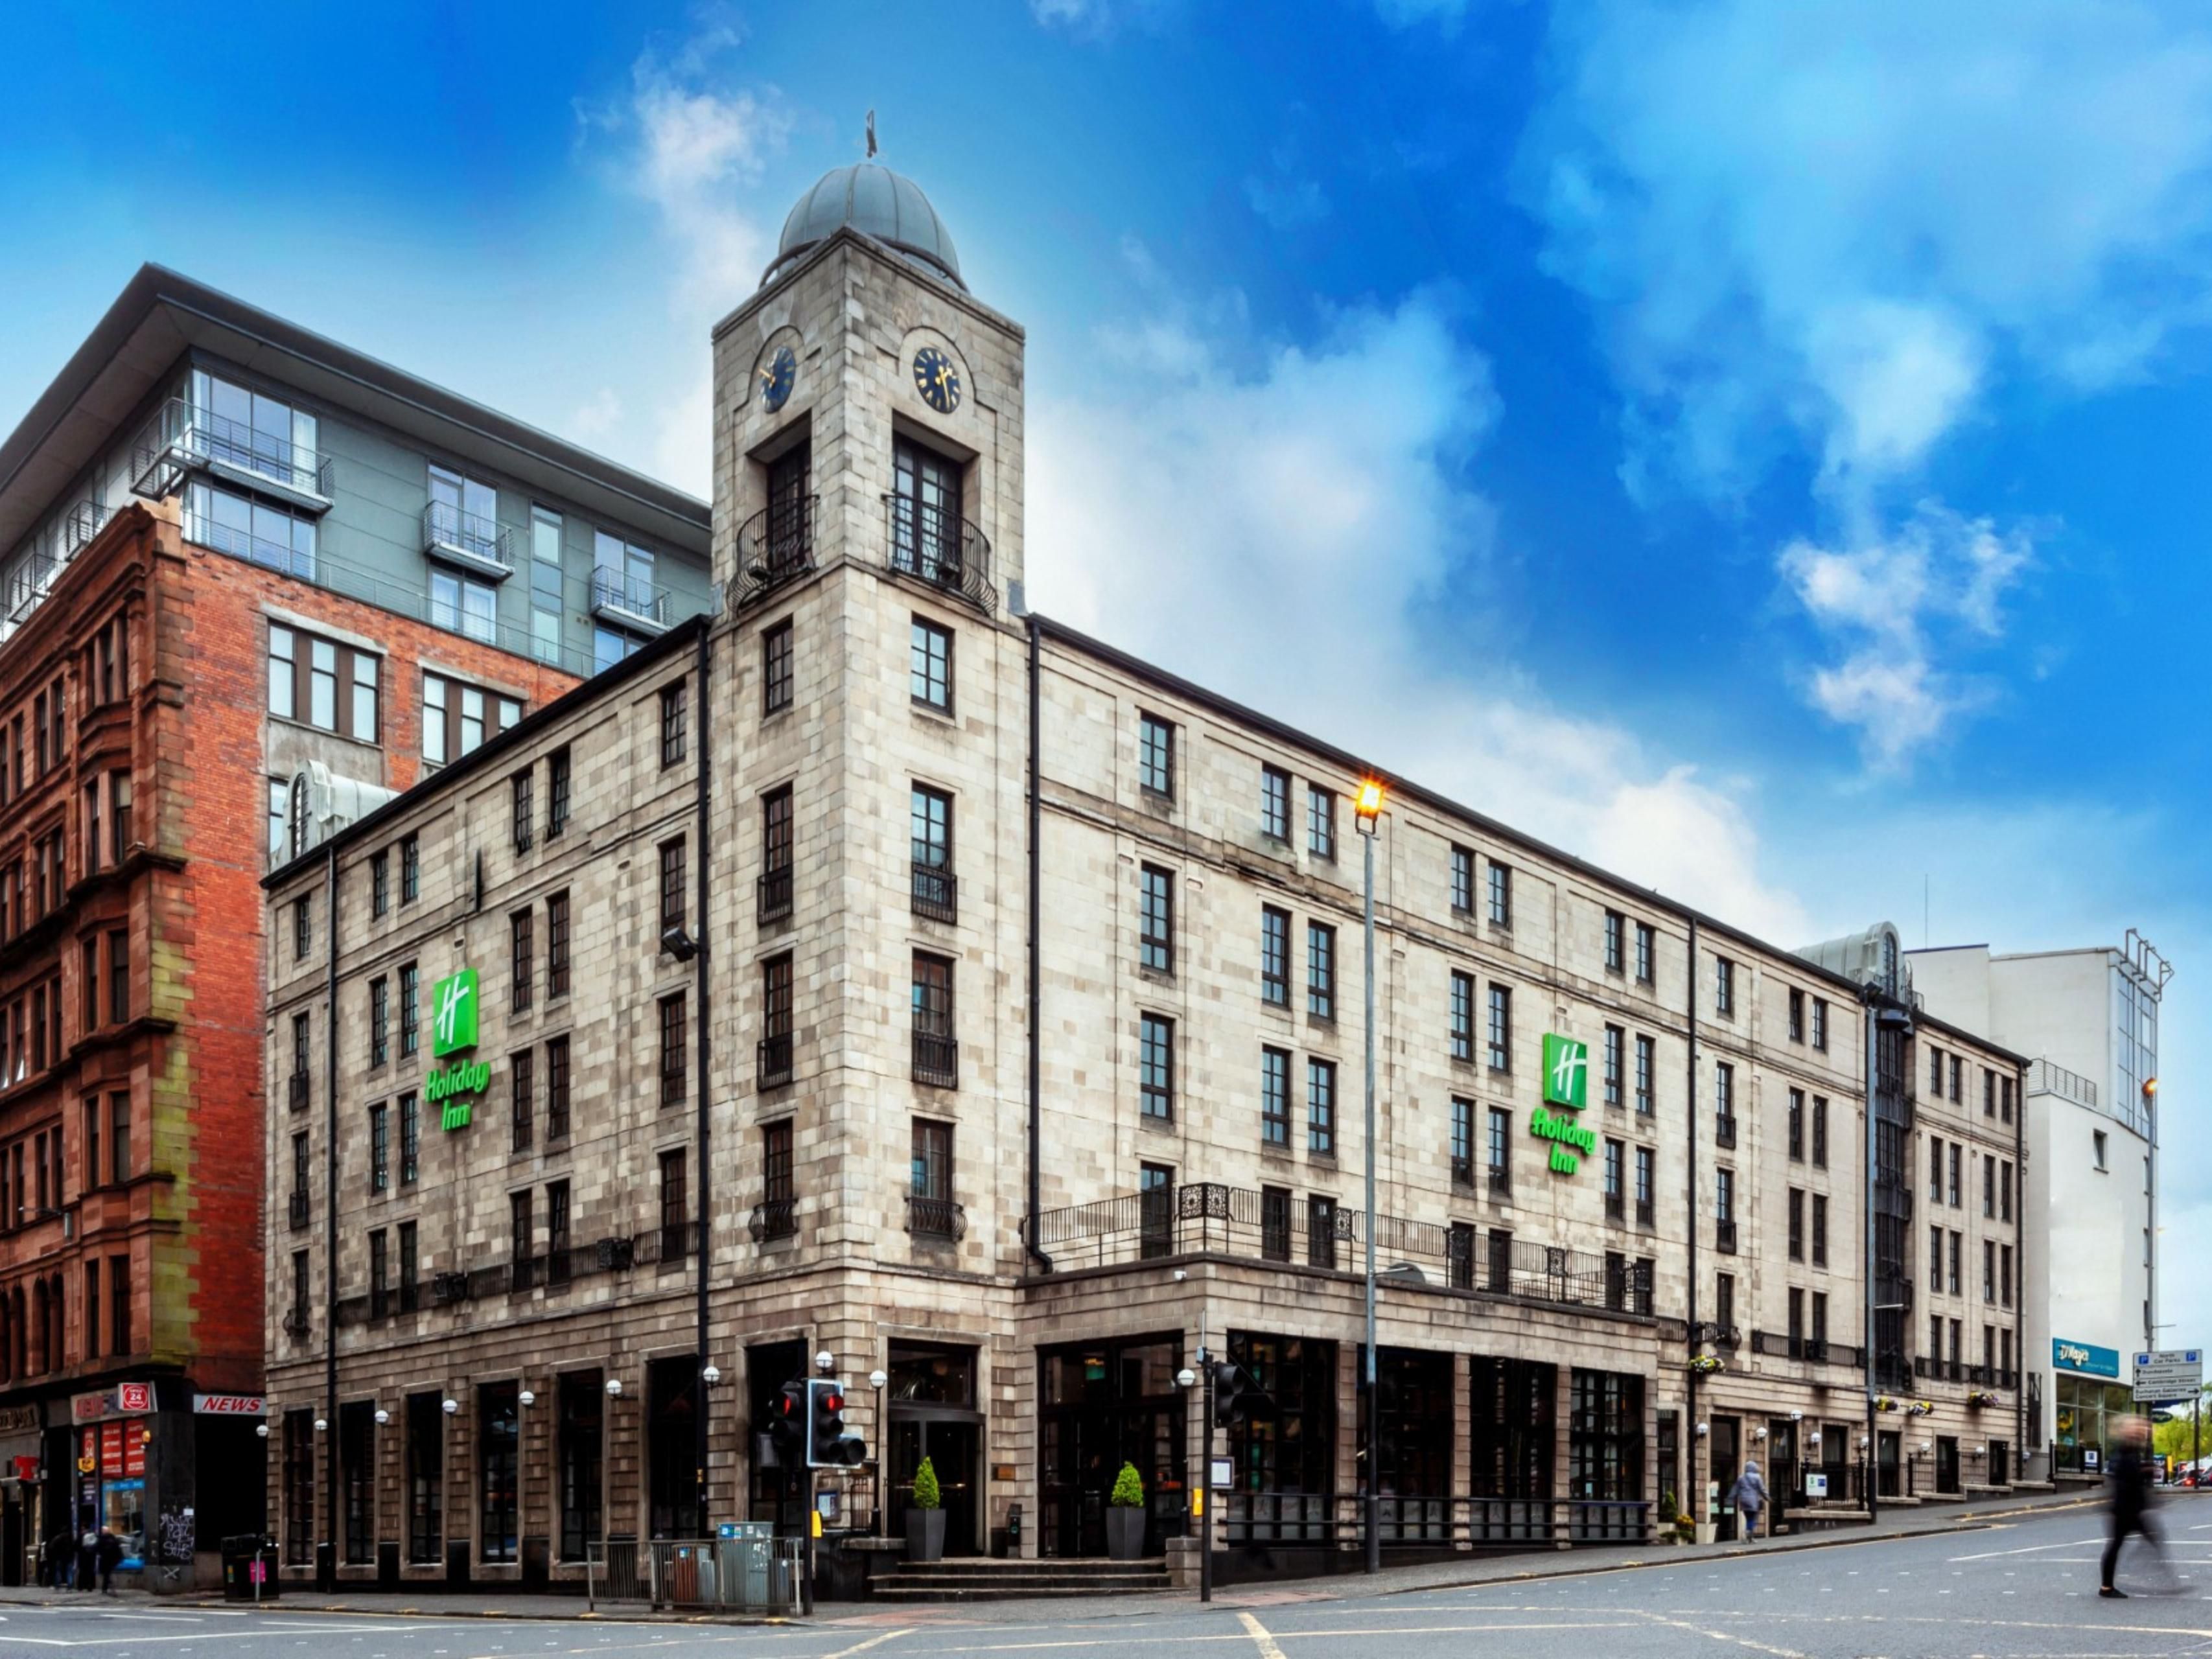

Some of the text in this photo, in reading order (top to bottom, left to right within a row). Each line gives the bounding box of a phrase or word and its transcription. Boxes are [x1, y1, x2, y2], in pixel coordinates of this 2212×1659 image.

[425, 1058, 491, 1103] Holiday
[441, 1099, 471, 1131] Inn
[1531, 1107, 1597, 1155] Holiday
[1550, 1143, 1579, 1175] Inn
[203, 1397, 261, 1411] NEWS
